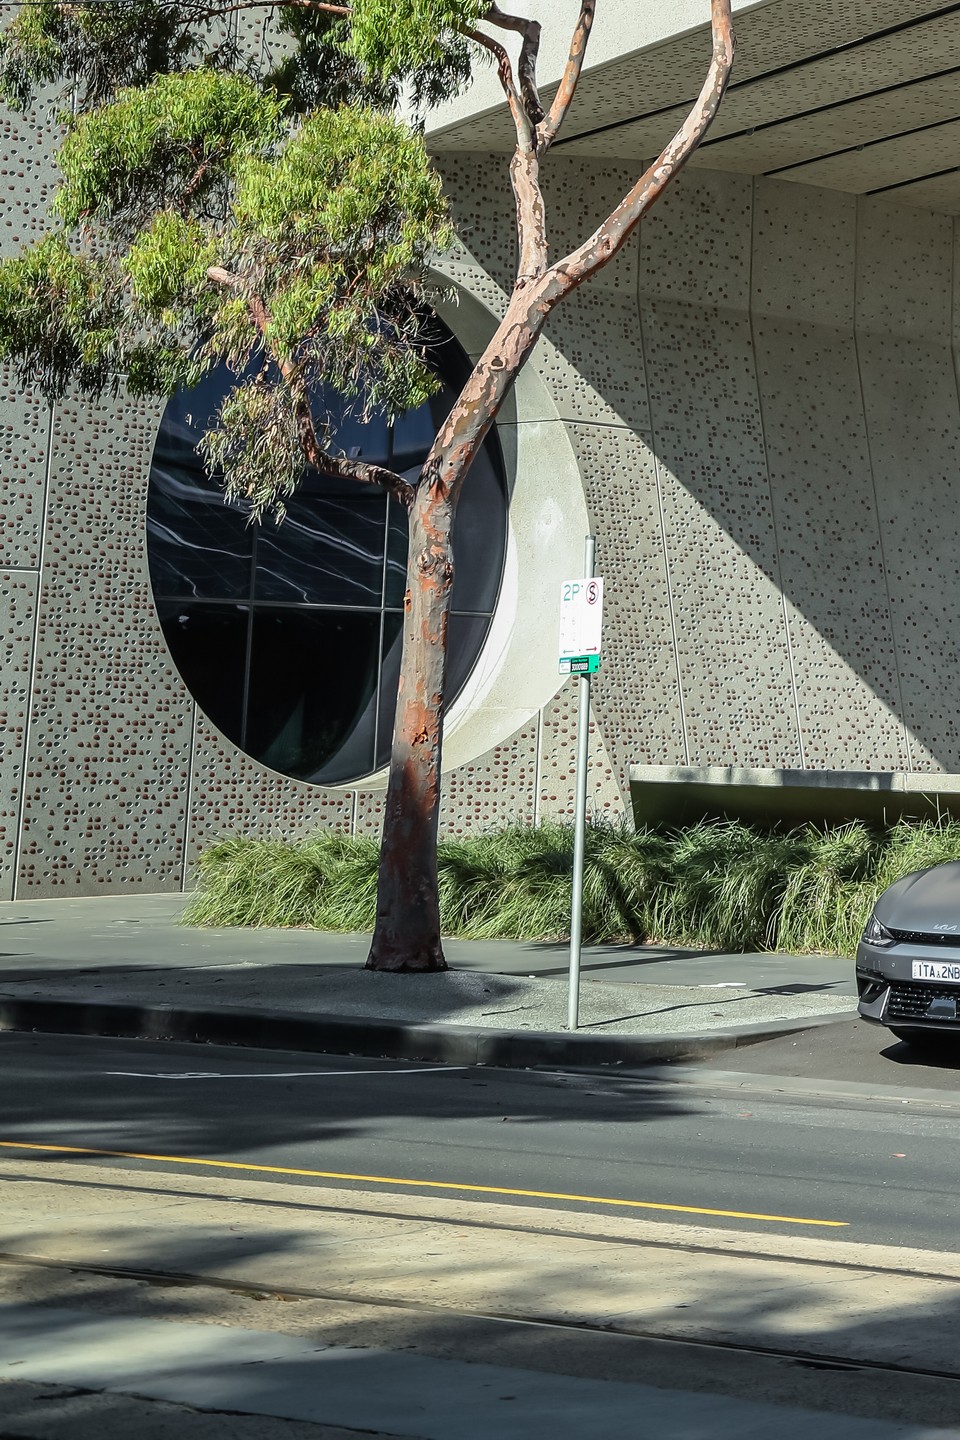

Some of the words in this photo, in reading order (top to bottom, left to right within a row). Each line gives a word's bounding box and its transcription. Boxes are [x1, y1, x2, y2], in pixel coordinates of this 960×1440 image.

[563, 583, 580, 601] 2P
[919, 964, 935, 978] 1TA
[941, 966, 960, 979] 2NB
